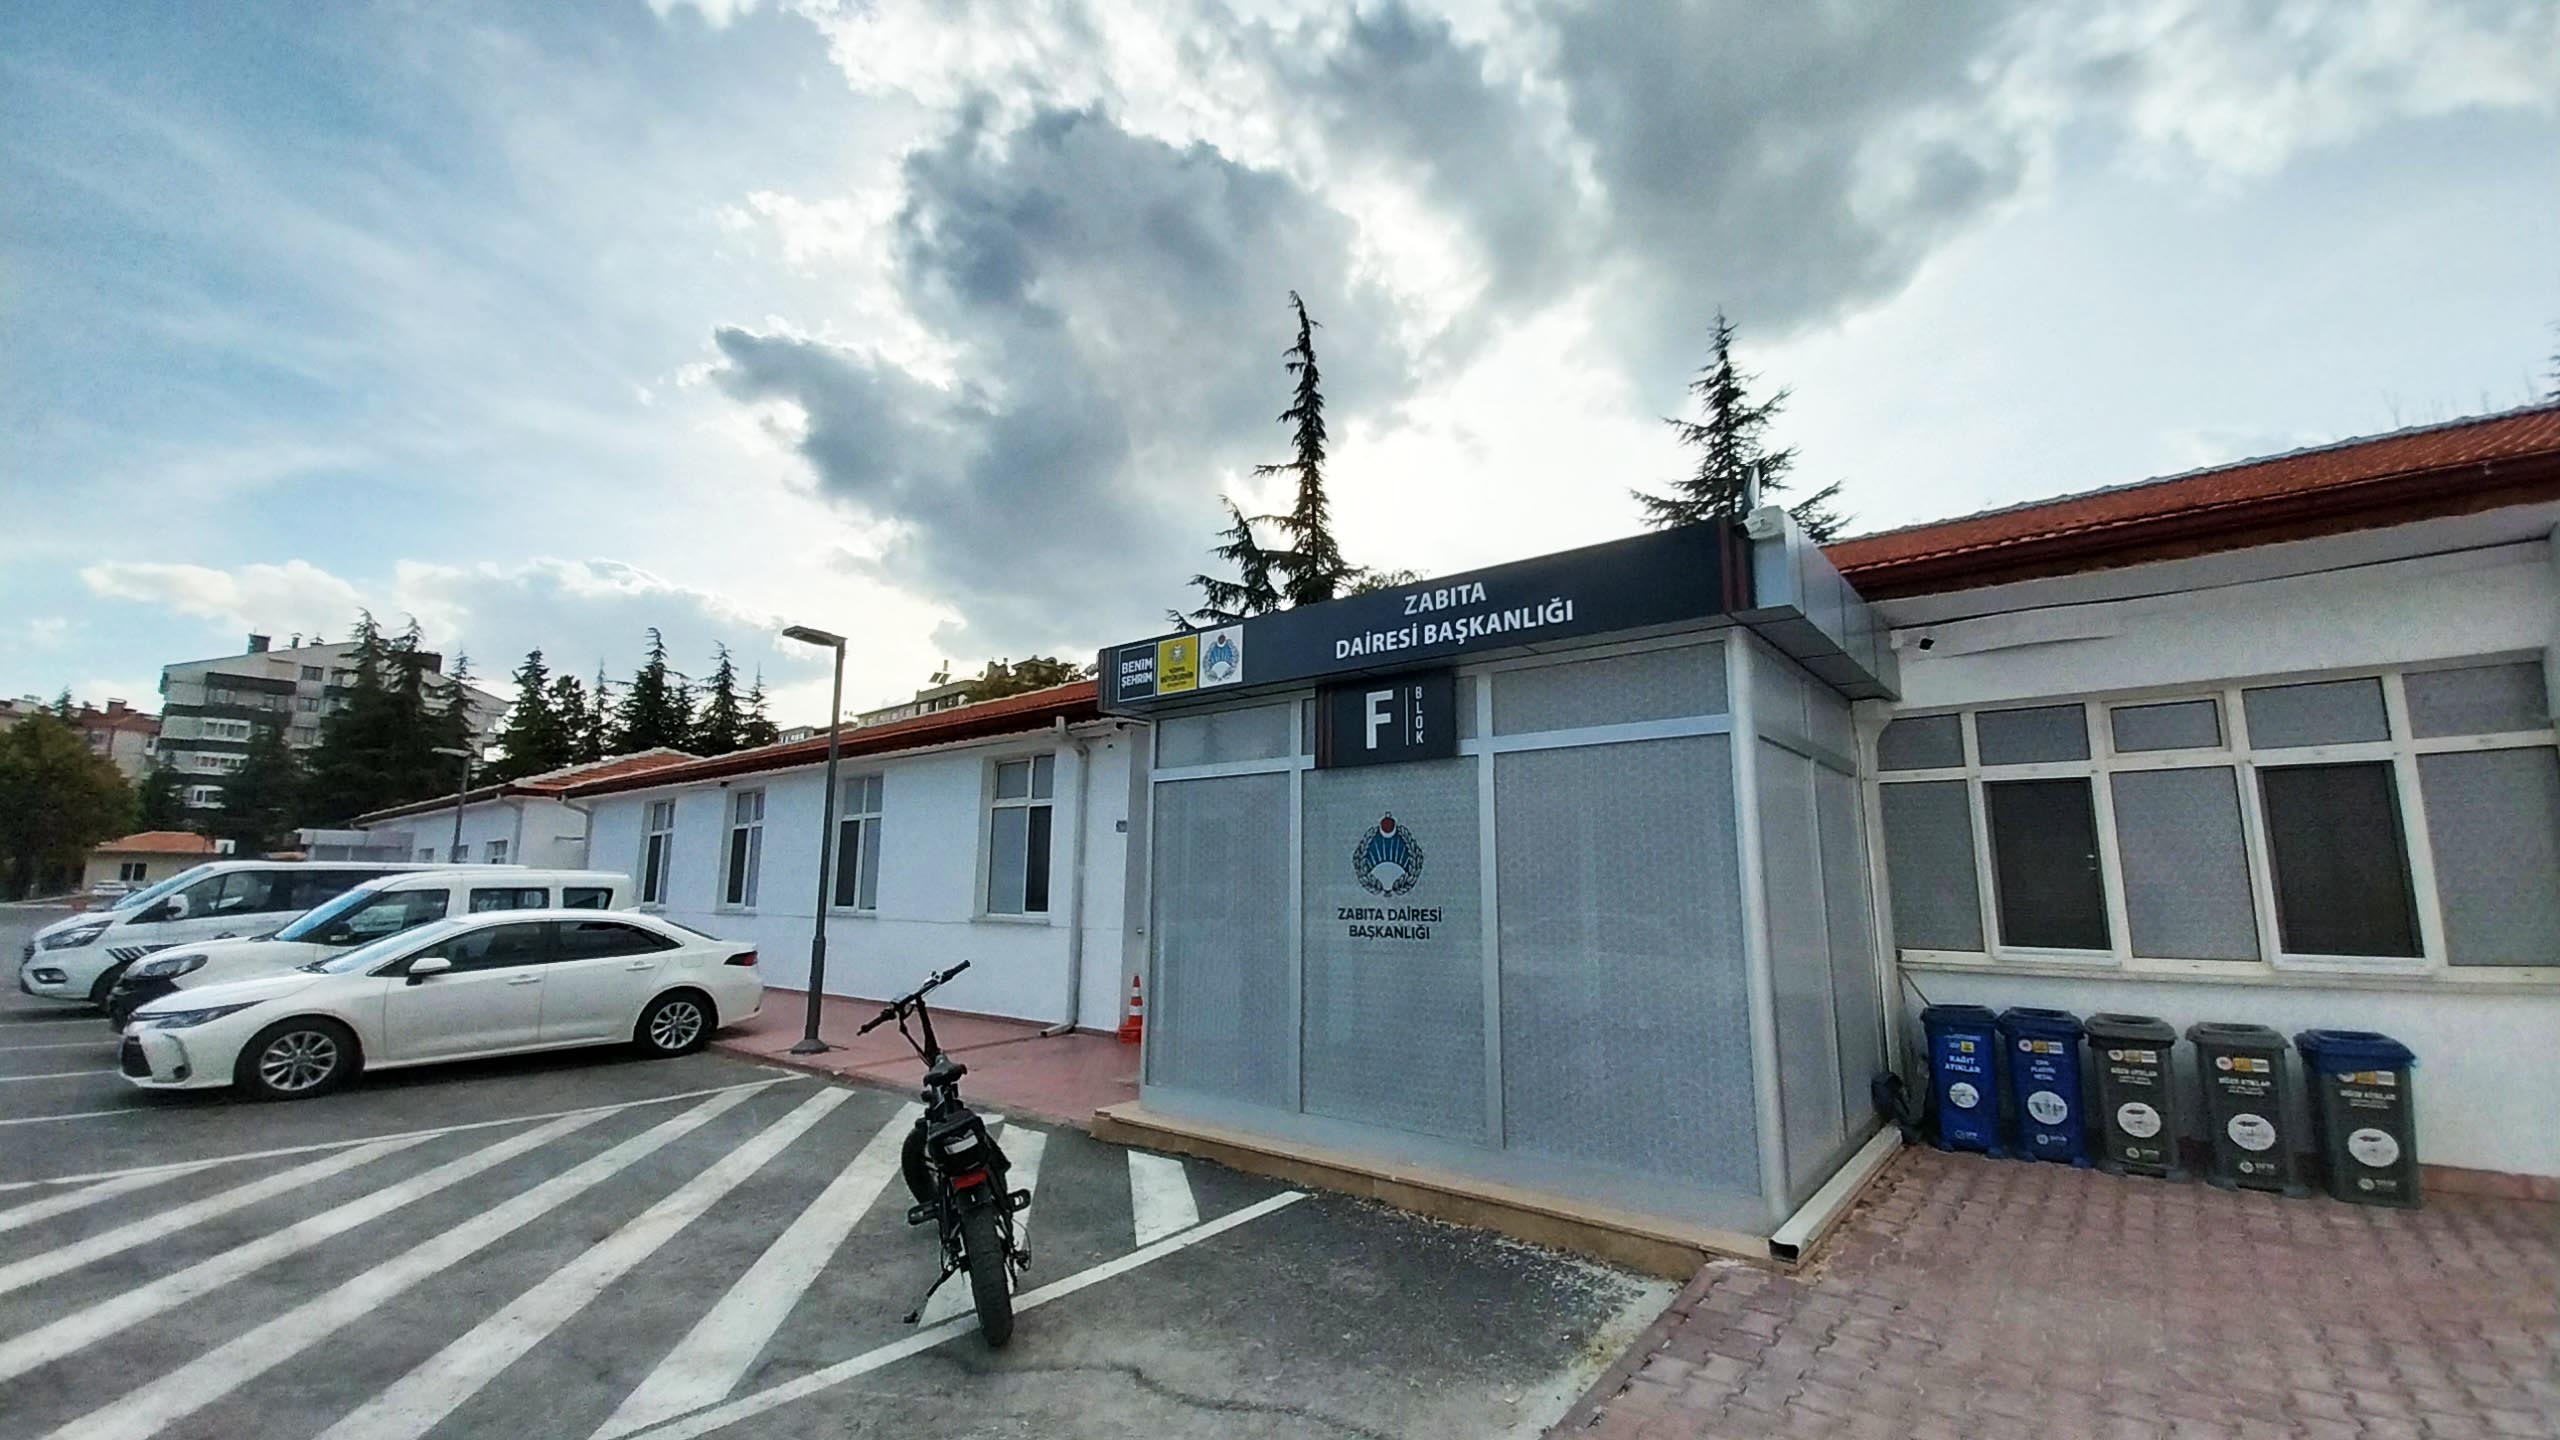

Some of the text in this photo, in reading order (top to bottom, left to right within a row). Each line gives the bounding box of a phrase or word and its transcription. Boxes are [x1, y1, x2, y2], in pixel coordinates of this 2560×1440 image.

[1404, 582, 1487, 615] ZABITA
[1336, 597, 1574, 659] DAİRESİ BAŞKANLIĞI
[1121, 657, 1153, 674] BENİM
[1121, 671, 1153, 688] ŞEHRİM
[1366, 689, 1393, 749] F
[1415, 686, 1424, 744] BLOK
[1337, 906, 1442, 922] ZABITA DAİRESİ
[1349, 925, 1430, 941] BAŞKANLIĞI
[1945, 1063, 1981, 1074] ATIKLAR
